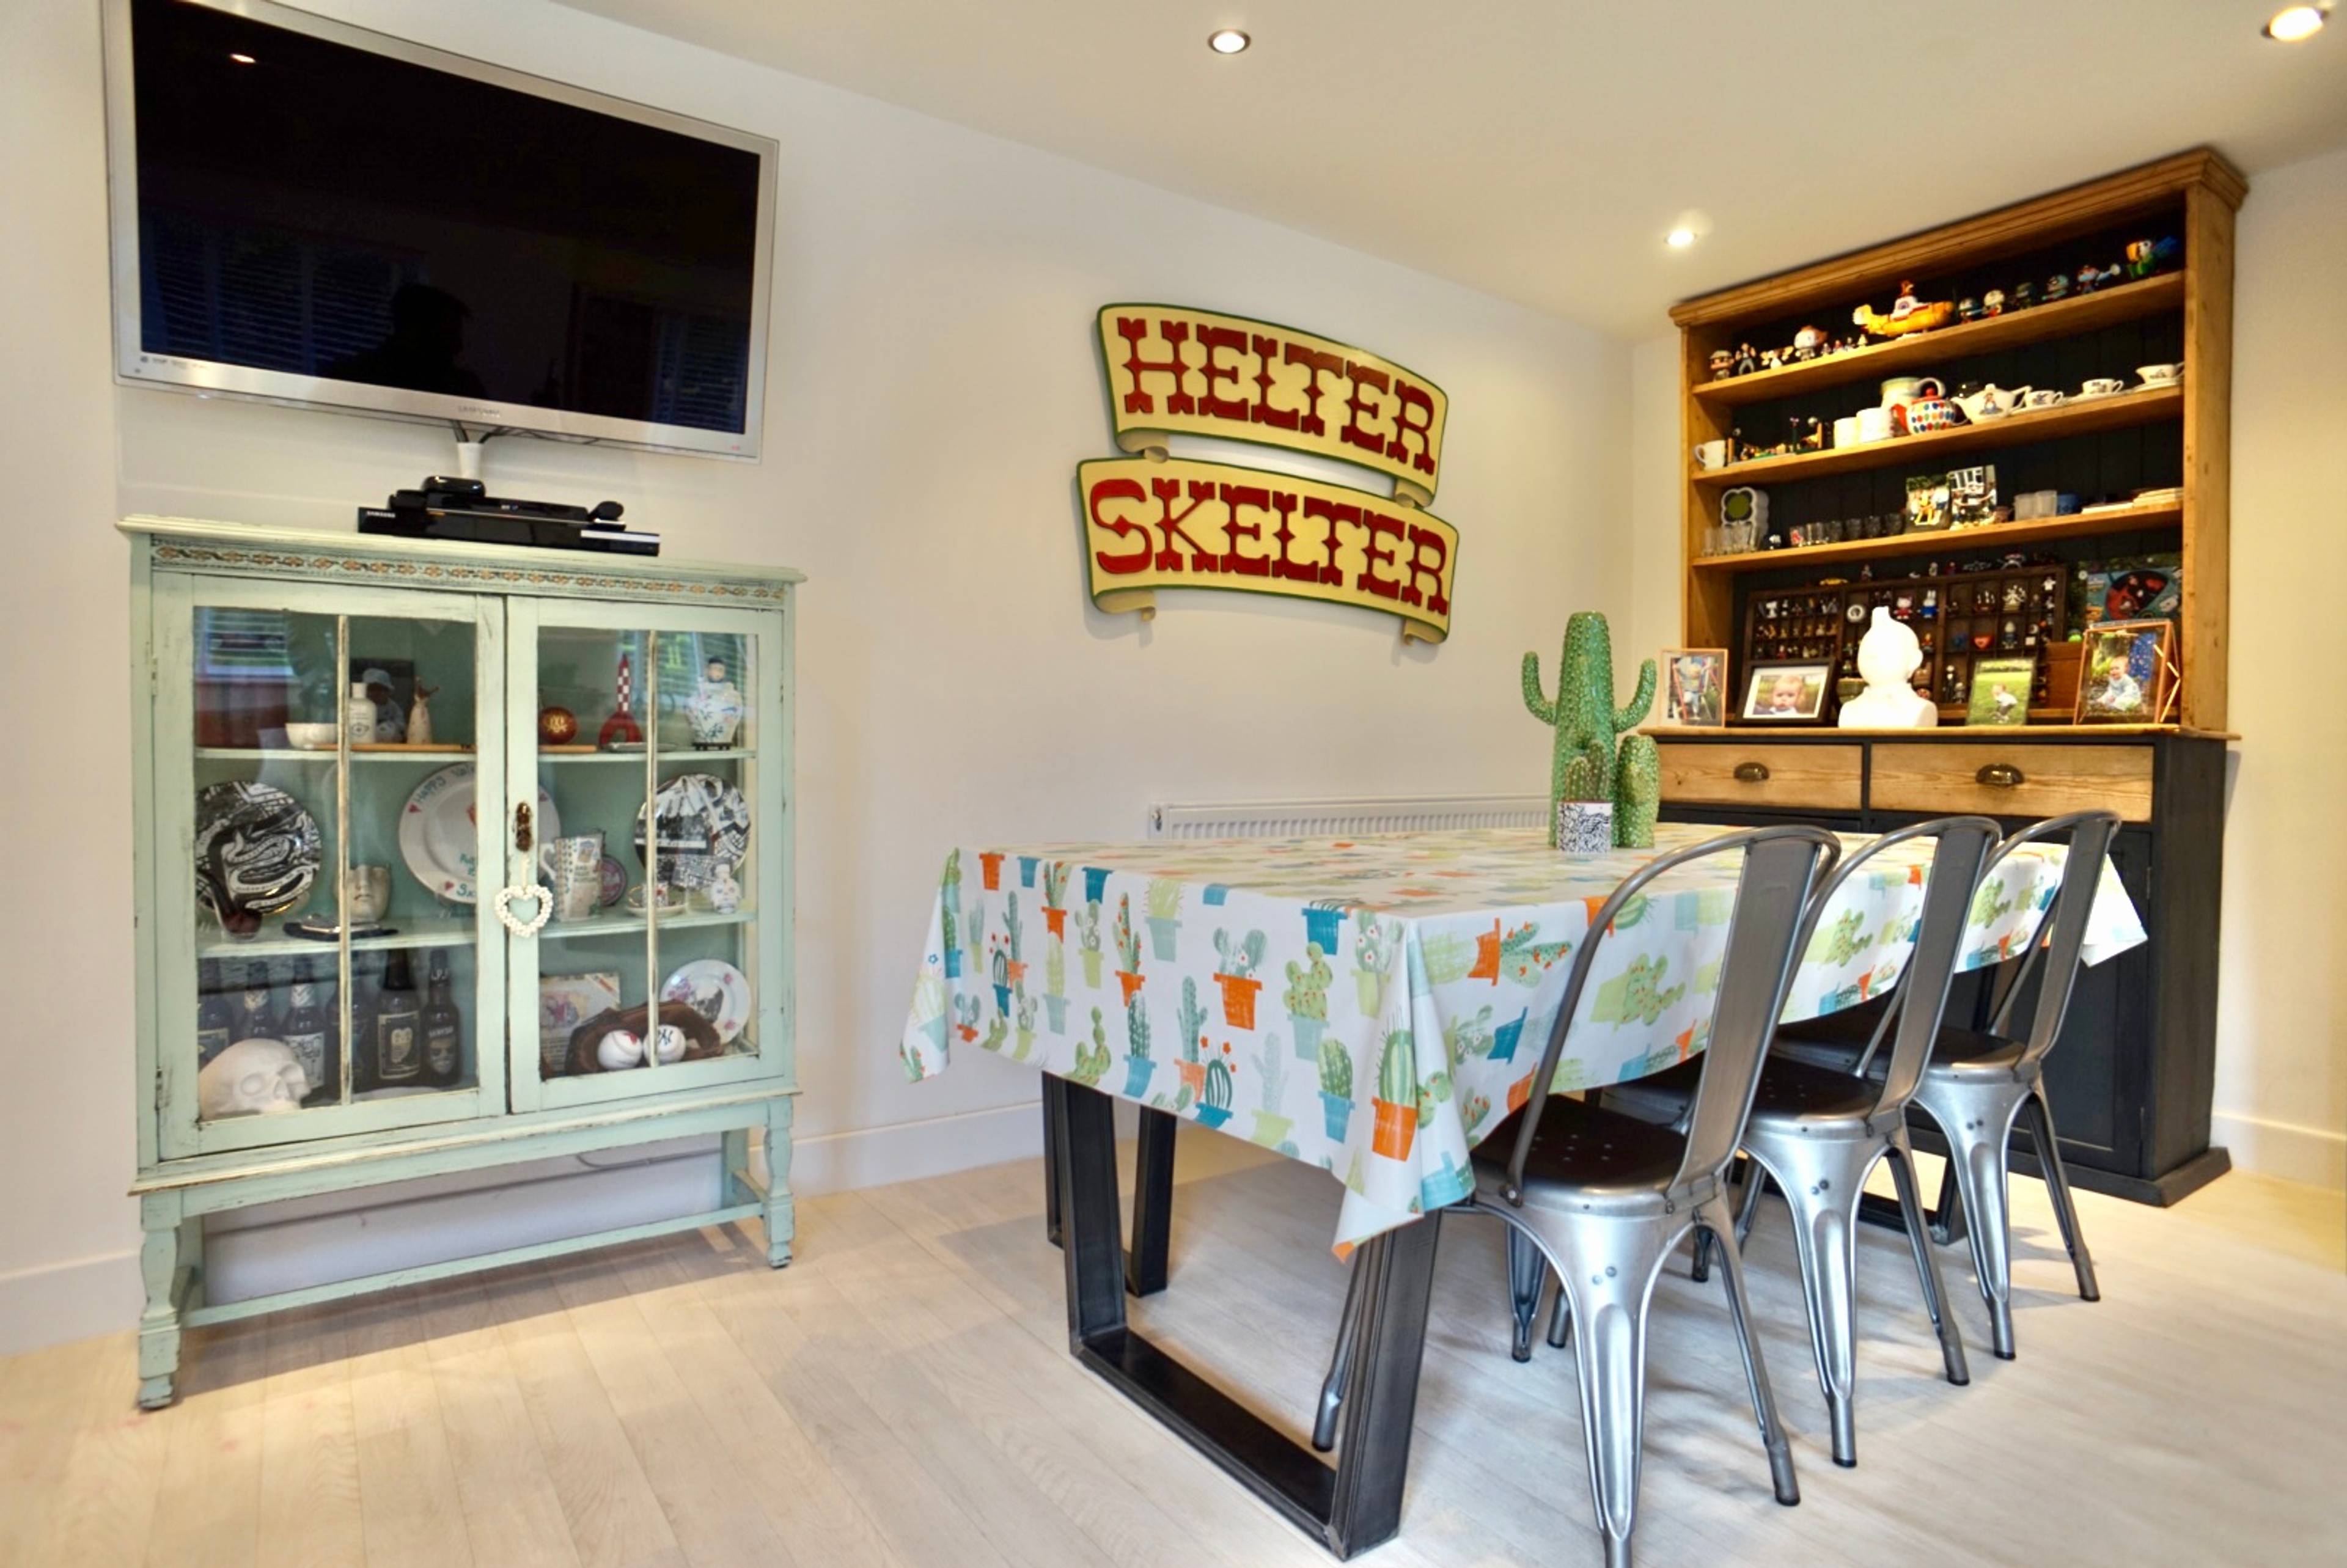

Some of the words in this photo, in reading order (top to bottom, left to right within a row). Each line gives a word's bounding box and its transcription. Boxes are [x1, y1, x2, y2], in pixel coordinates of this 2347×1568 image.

[457, 405, 500, 415] SAMSUNG
[1117, 317, 1435, 476] HELTER
[1090, 477, 1449, 616] SKELTER
